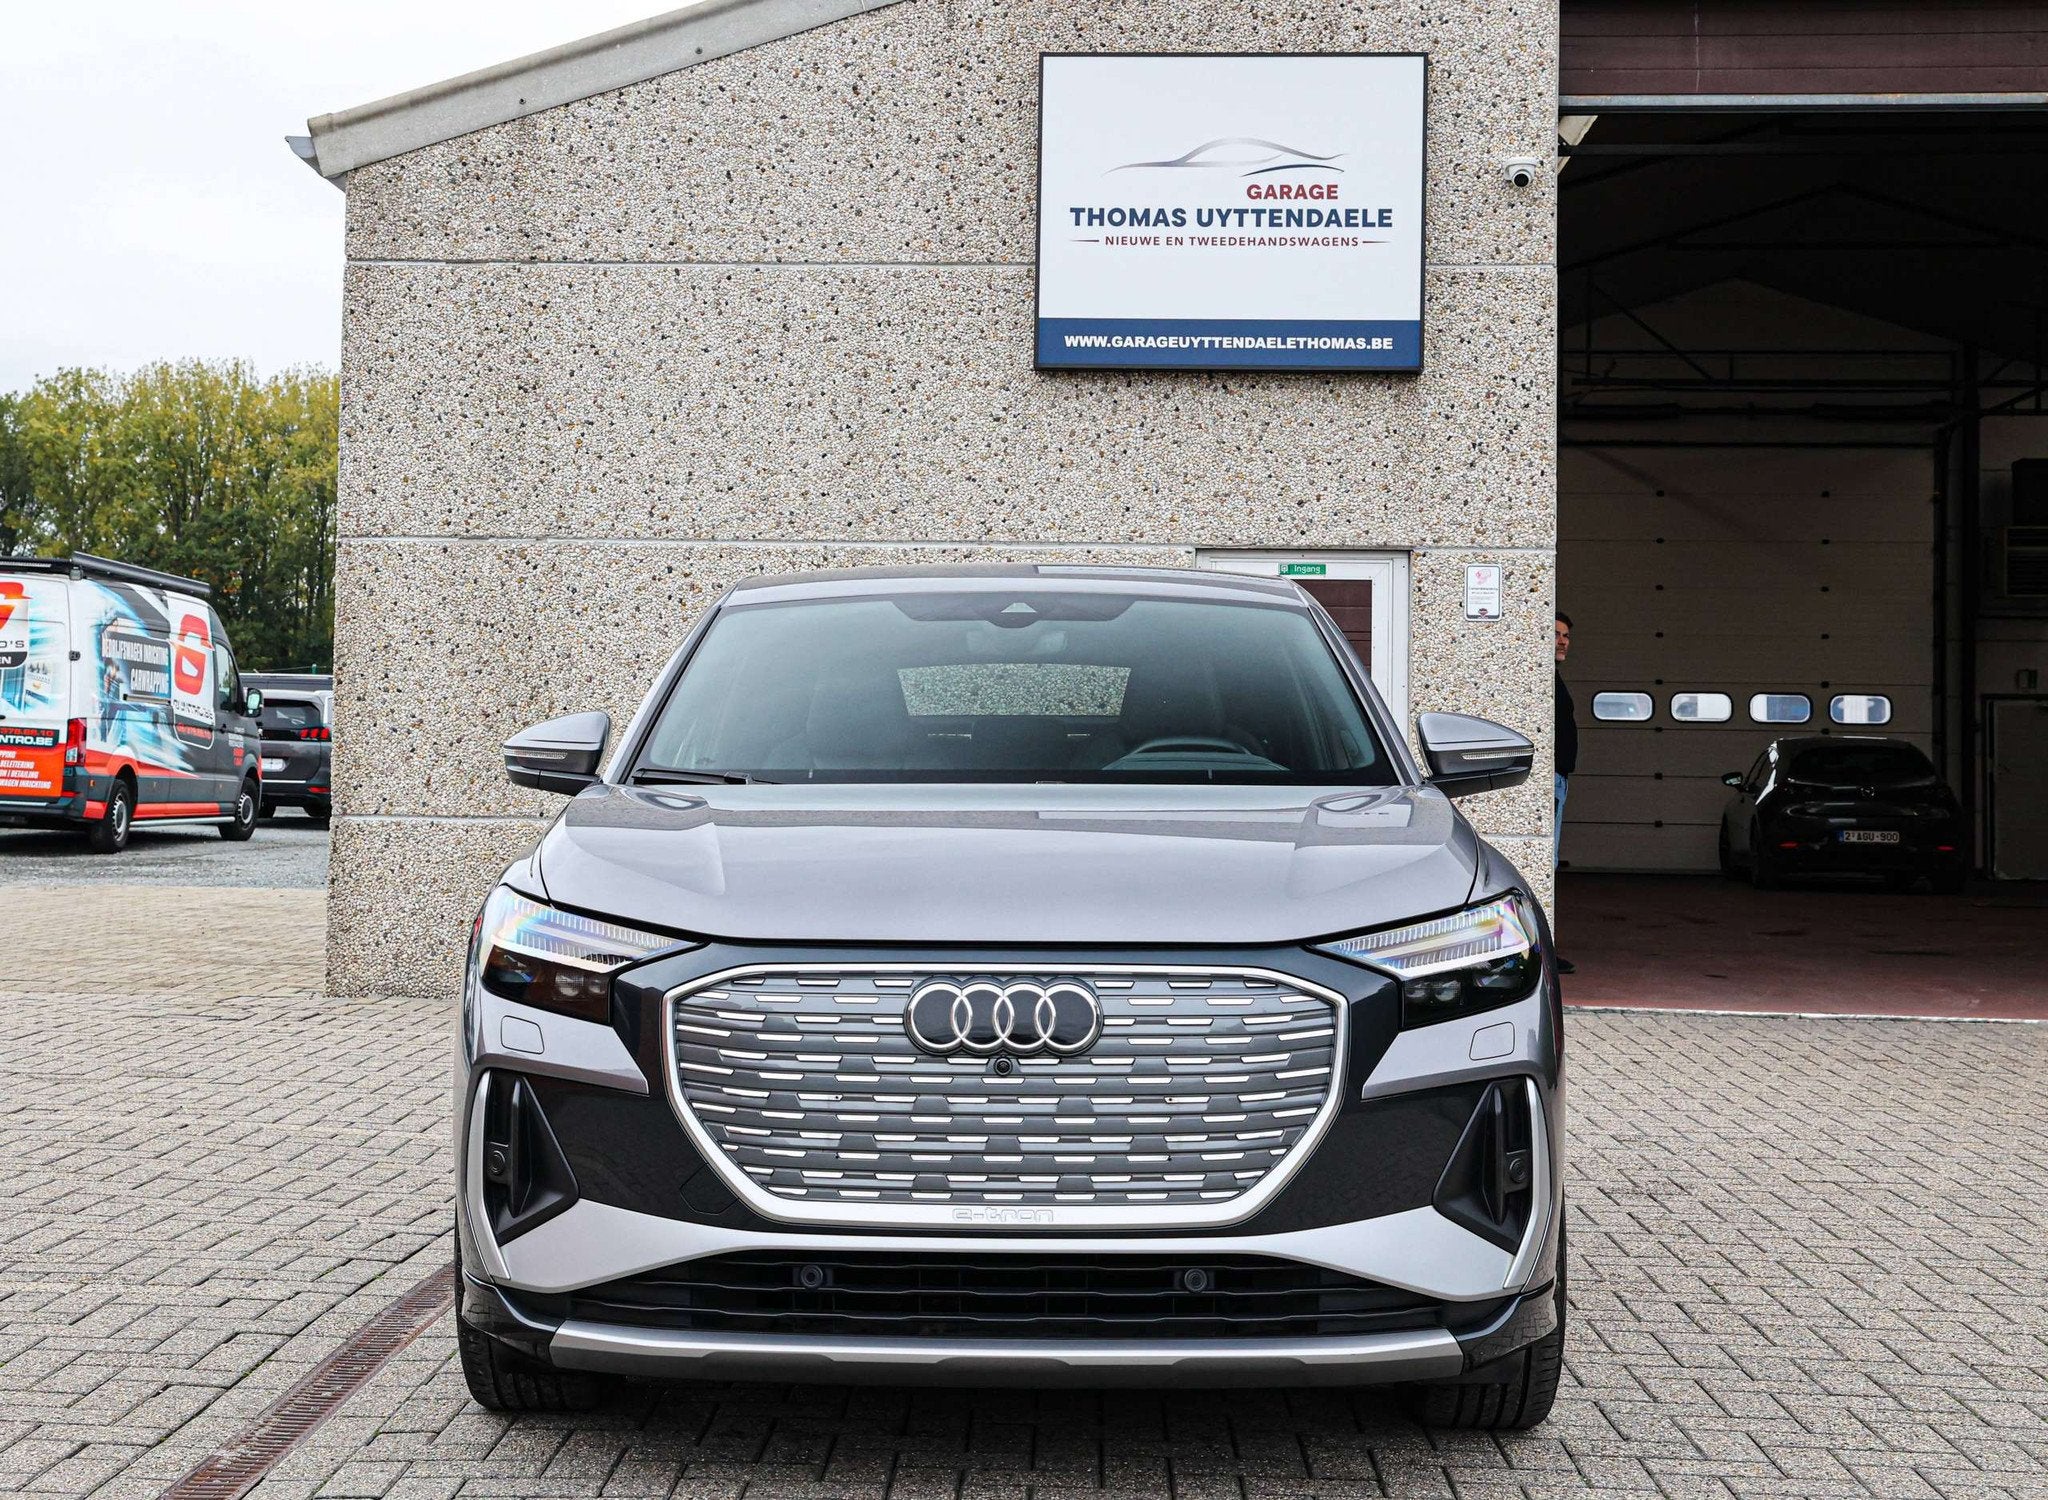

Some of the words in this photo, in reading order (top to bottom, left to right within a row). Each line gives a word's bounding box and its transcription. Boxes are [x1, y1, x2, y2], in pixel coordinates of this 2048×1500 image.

[1246, 184, 1339, 200] GARAGE
[1069, 207, 1187, 227] THOMAS
[1197, 208, 1393, 228] UYTTENDAELE
[1105, 236, 1161, 246] NIEUWE
[1166, 236, 1184, 246] EN
[1189, 236, 1359, 247] TWEEDEHANDSWAGENS
[1064, 335, 1393, 350] WWW.GARAGEUYTTENDAELETHOMAS.BE
[1294, 565, 1321, 574] Ingang
[951, 1206, 1054, 1222] e-tron
